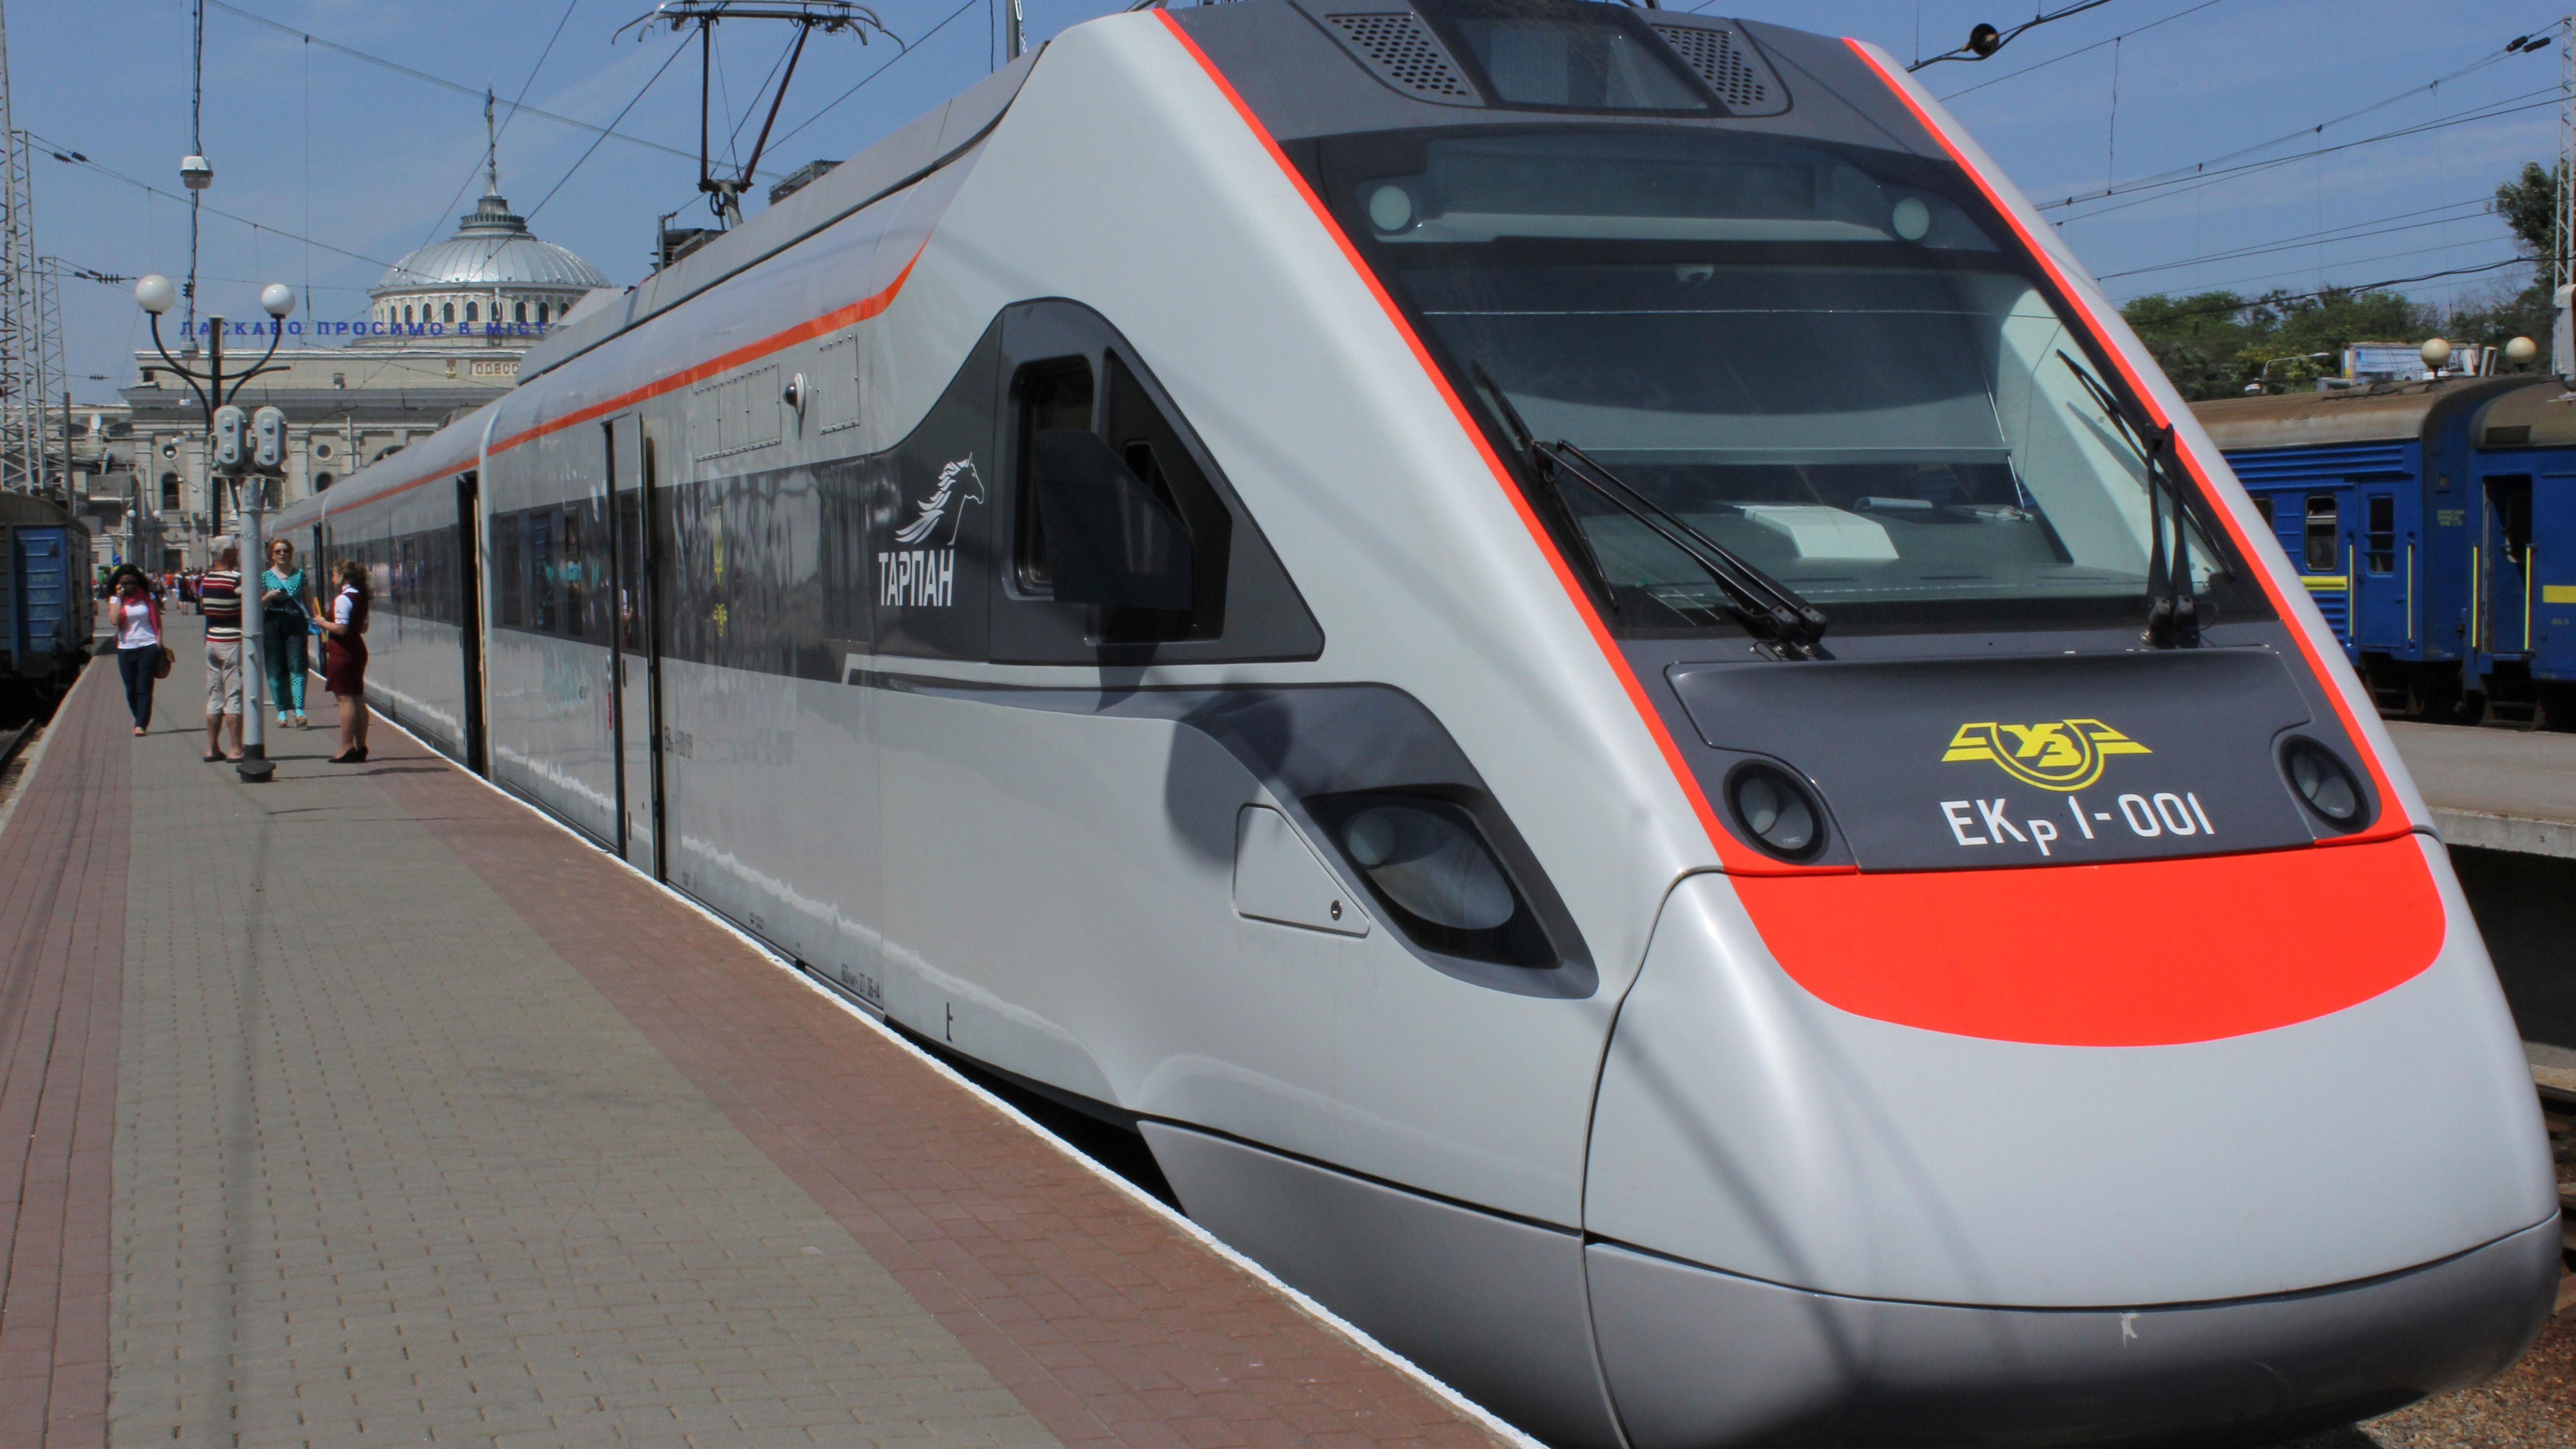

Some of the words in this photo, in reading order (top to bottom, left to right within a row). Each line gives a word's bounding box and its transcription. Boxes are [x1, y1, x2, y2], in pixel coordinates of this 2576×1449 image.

[317, 322, 444, 335] ПРОСИМО
[459, 322, 470, 334] В
[485, 322, 556, 334] МІСТ
[879, 549, 954, 606] ТАРПАН
